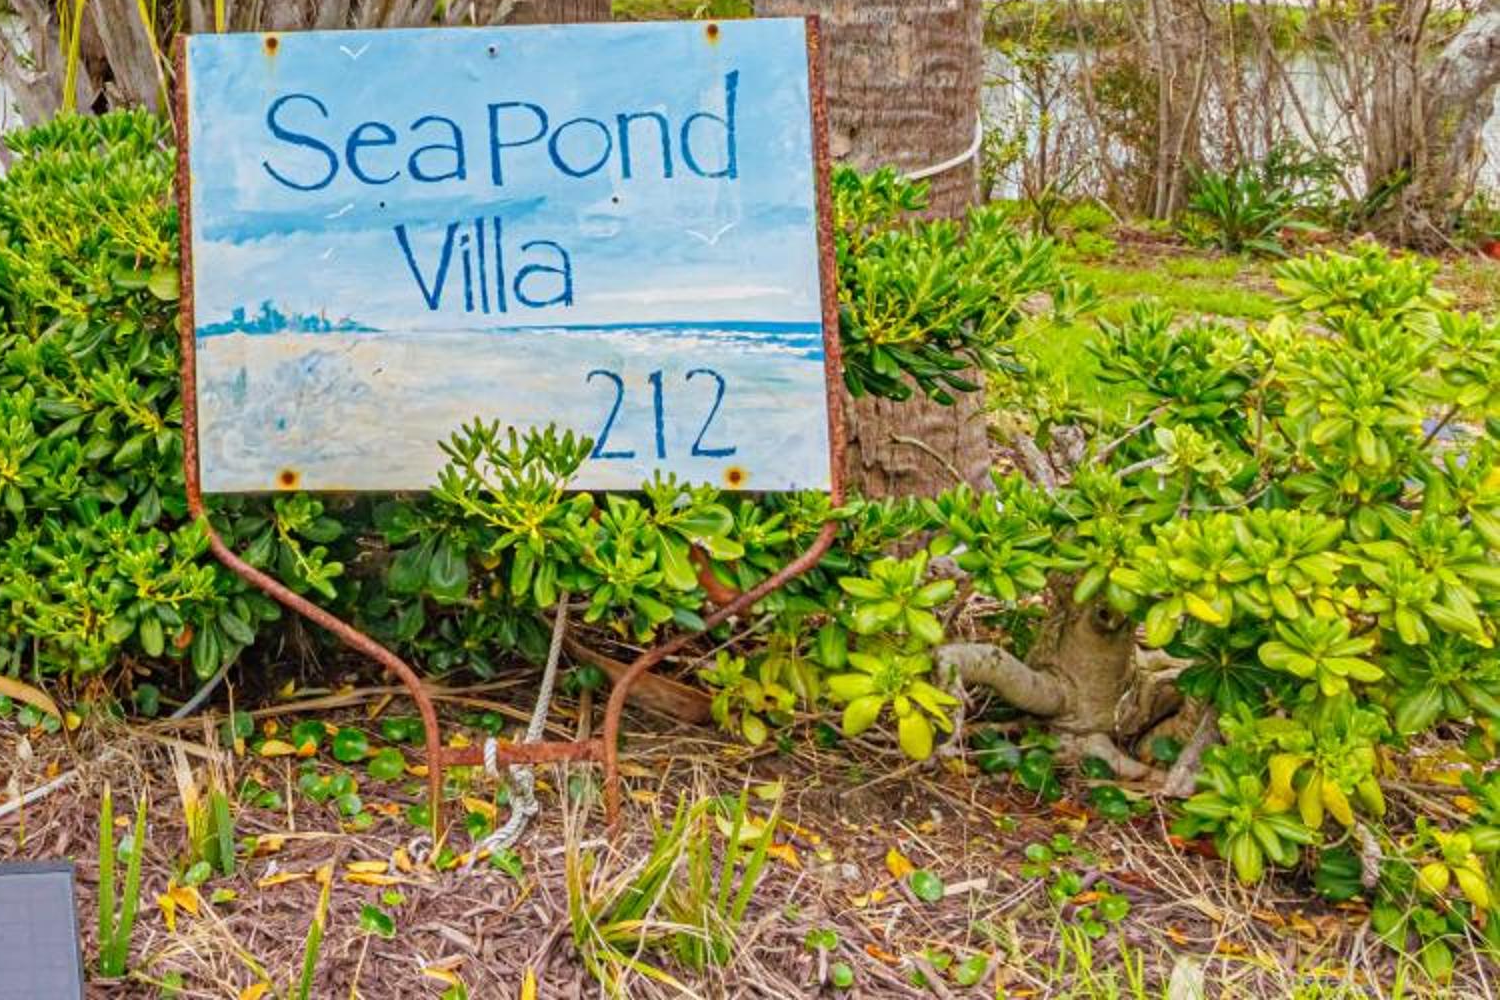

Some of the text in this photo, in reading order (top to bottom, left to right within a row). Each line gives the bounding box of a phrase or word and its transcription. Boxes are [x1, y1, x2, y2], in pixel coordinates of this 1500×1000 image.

[263, 69, 739, 191] Sea Pond
[394, 215, 574, 314] Villa
[586, 369, 738, 460] 212
